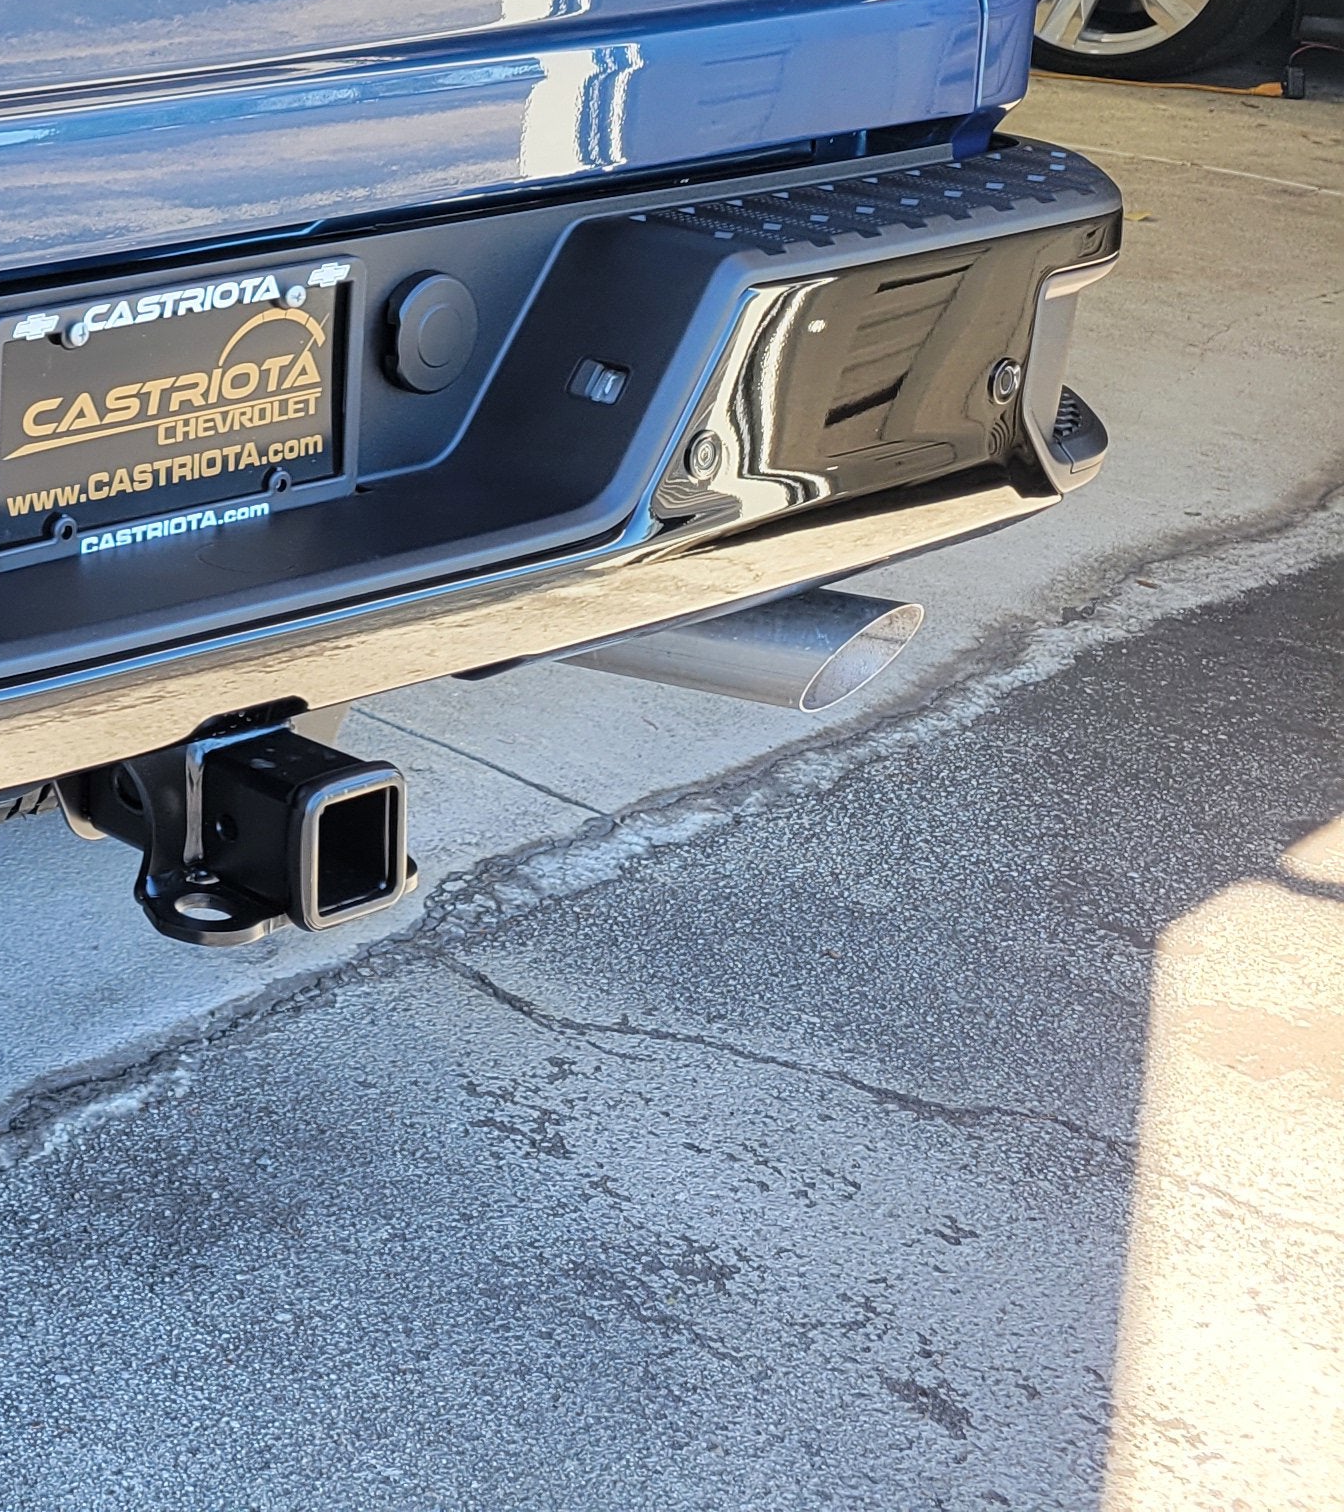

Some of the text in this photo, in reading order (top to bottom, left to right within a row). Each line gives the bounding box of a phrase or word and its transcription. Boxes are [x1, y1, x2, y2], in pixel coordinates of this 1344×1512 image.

[82, 273, 280, 333] CASTRIOTA
[22, 349, 322, 438] CASTRIOTA
[157, 392, 322, 447] CHEVROLET
[6, 434, 323, 518] www.CASTRIOTA.com
[80, 501, 270, 555] CASTRIOTA.com
